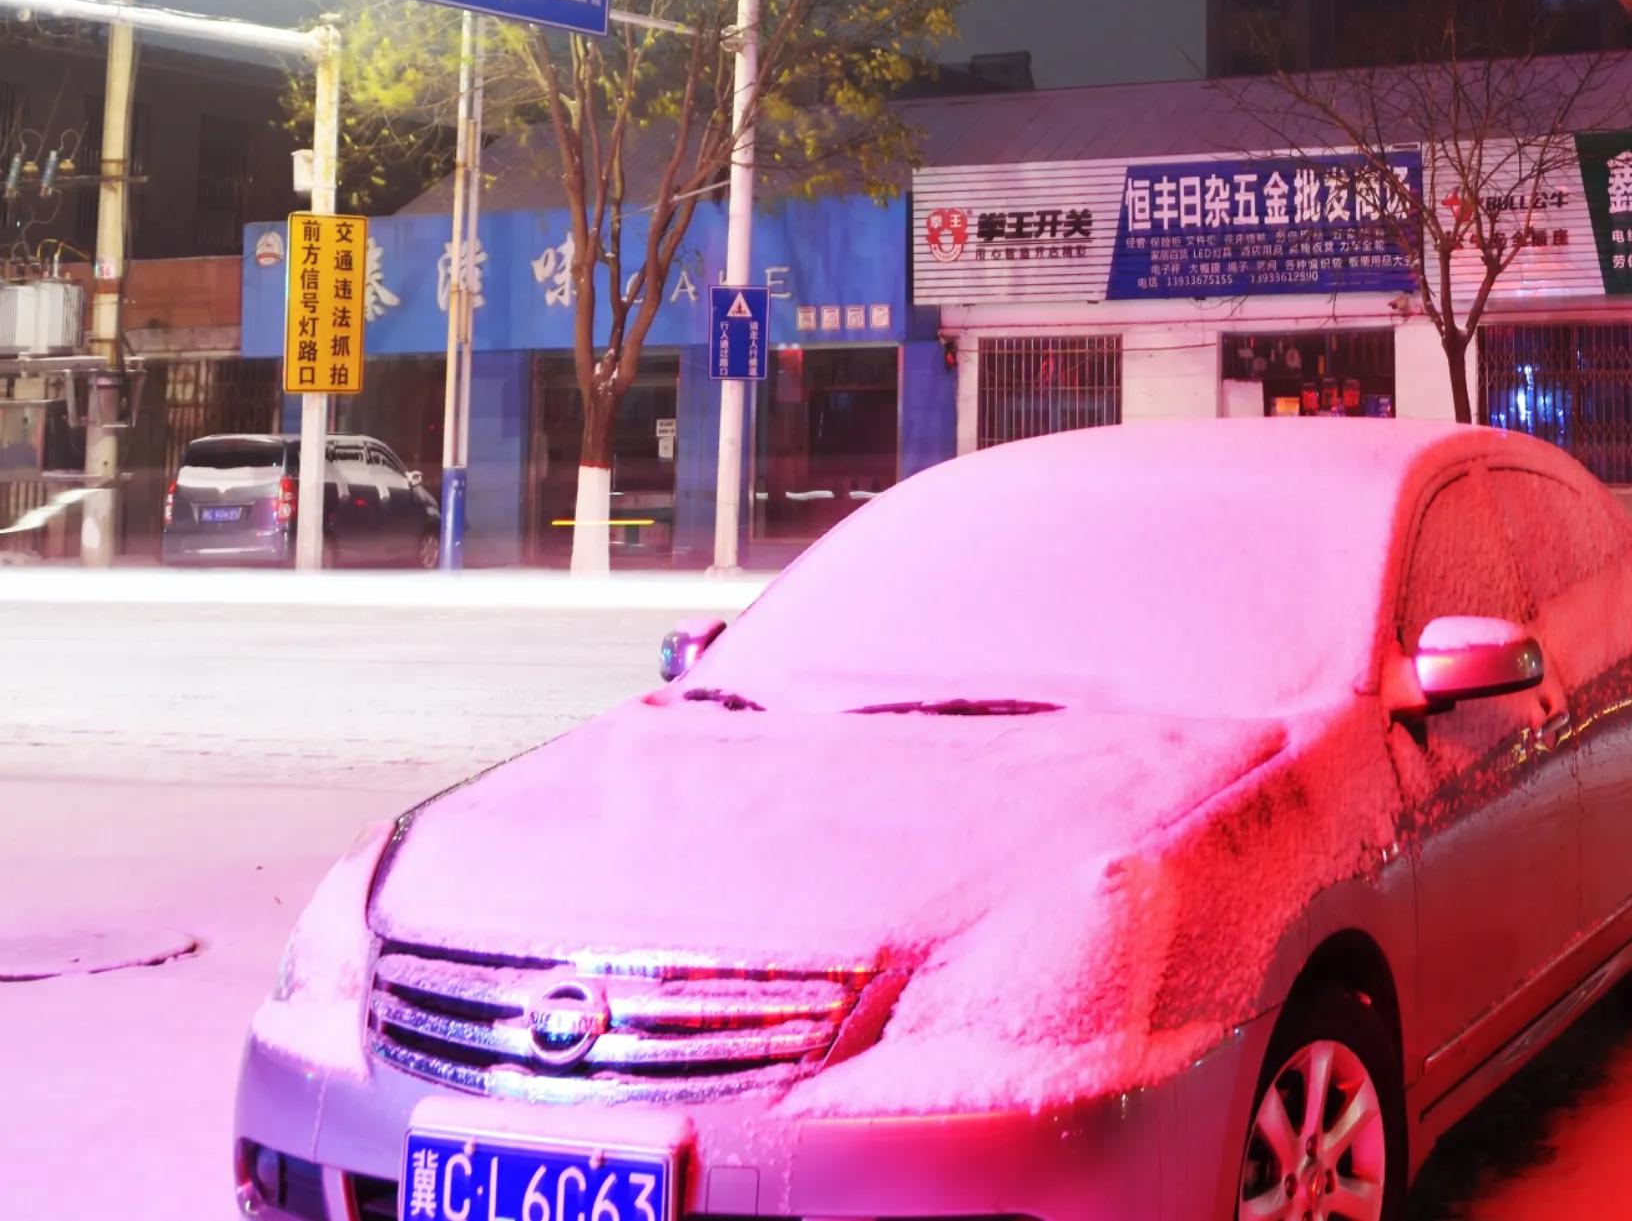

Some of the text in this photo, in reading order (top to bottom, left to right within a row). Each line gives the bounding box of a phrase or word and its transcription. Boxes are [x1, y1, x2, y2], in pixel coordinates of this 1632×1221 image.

[298, 220, 321, 385] 前方信号灯路口
[330, 221, 354, 386] 交通违法抓拍
[976, 209, 1094, 242] 拳王开关
